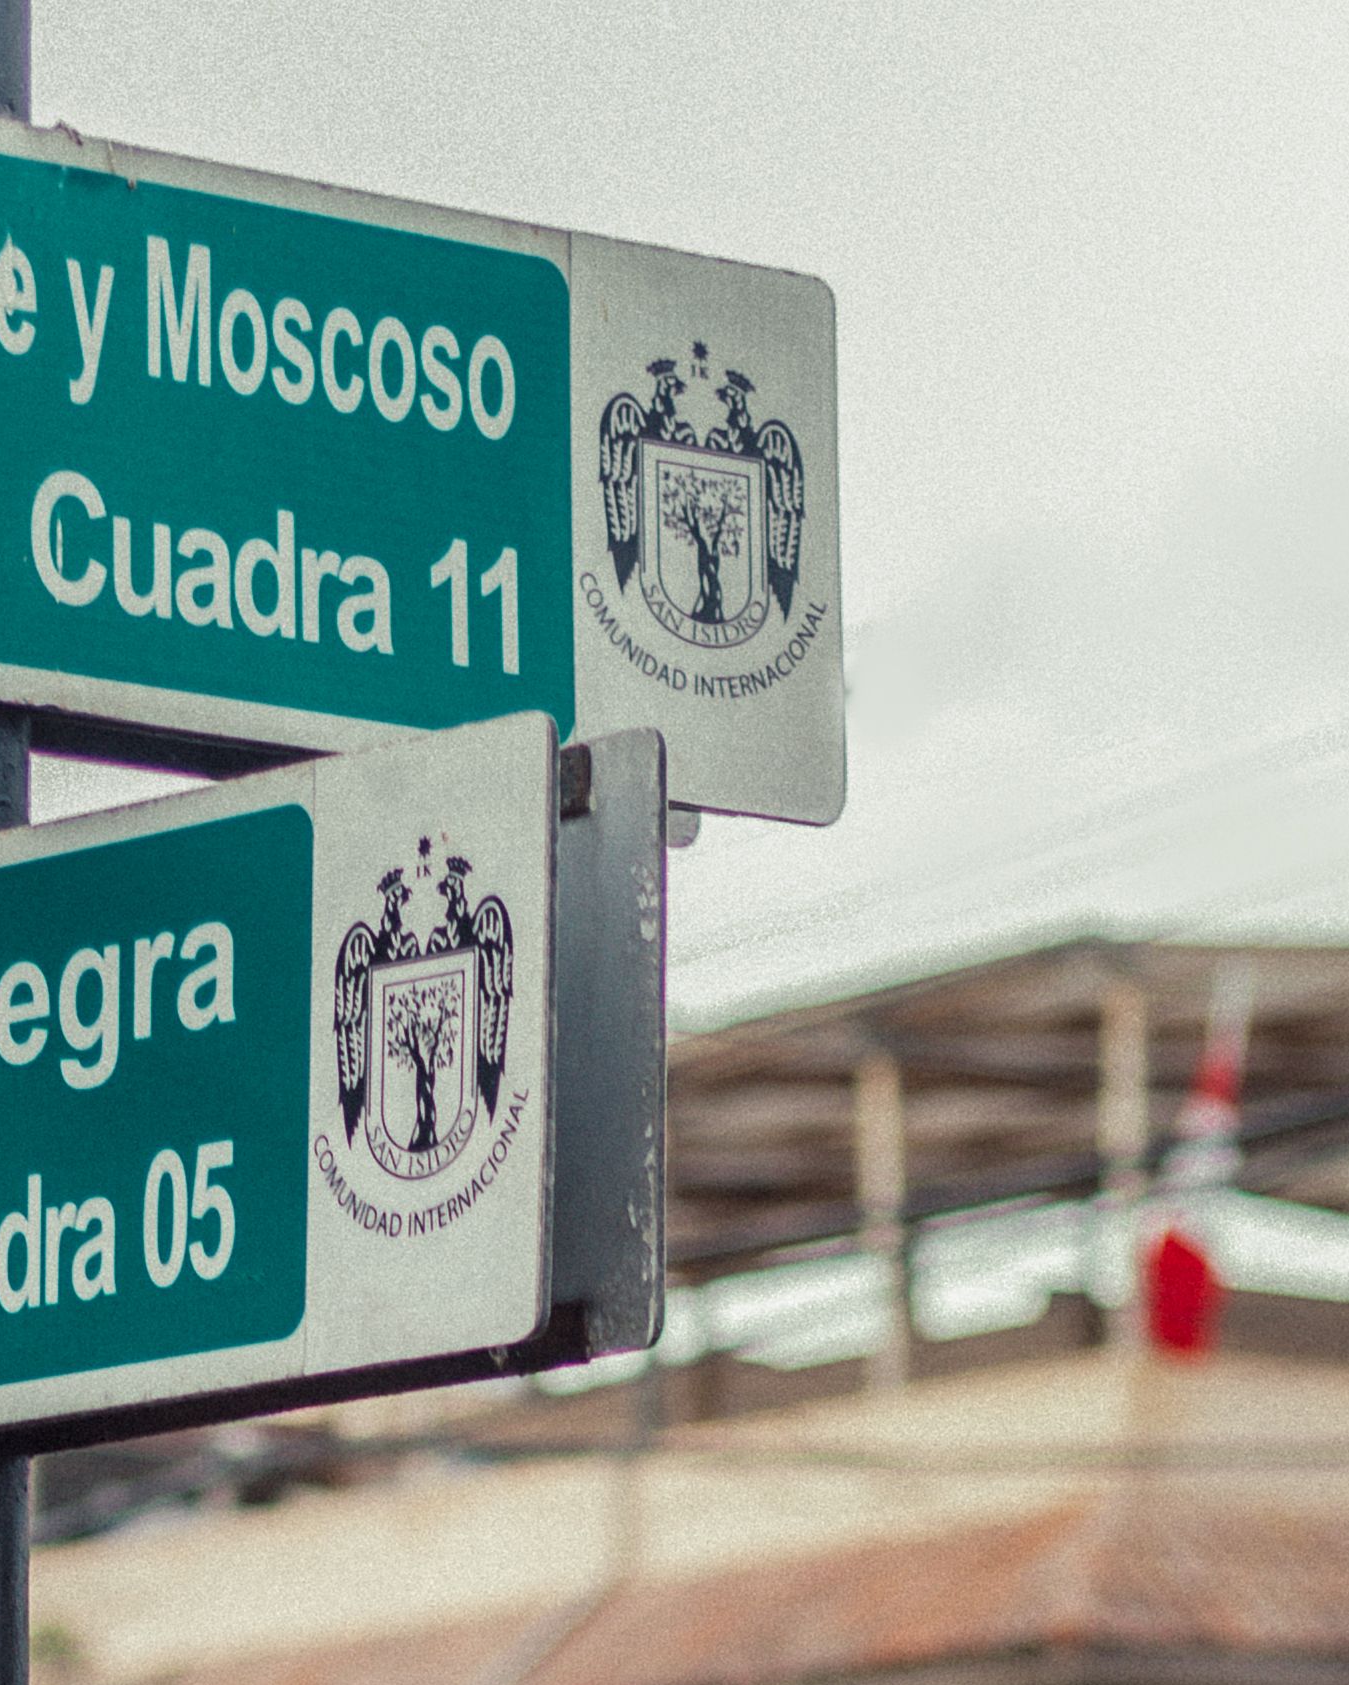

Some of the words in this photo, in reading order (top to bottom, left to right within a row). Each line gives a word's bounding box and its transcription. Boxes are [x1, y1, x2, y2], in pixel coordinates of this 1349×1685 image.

[66, 259, 115, 405] y
[146, 235, 517, 440] Moscoso
[30, 469, 394, 656] Cuadra
[430, 538, 520, 675] 11
[579, 571, 687, 691] COMUNIDAD
[694, 601, 828, 699] INTERNACIONAL
[642, 584, 684, 632] SAN
[691, 600, 767, 644] ISIDRO
[142, 1139, 236, 1288] 05
[313, 1134, 403, 1238] COMUNIDAD
[407, 1087, 530, 1238] INTERNACIONAL
[367, 1125, 403, 1172] SAN
[407, 1108, 474, 1176] ISIDRO
